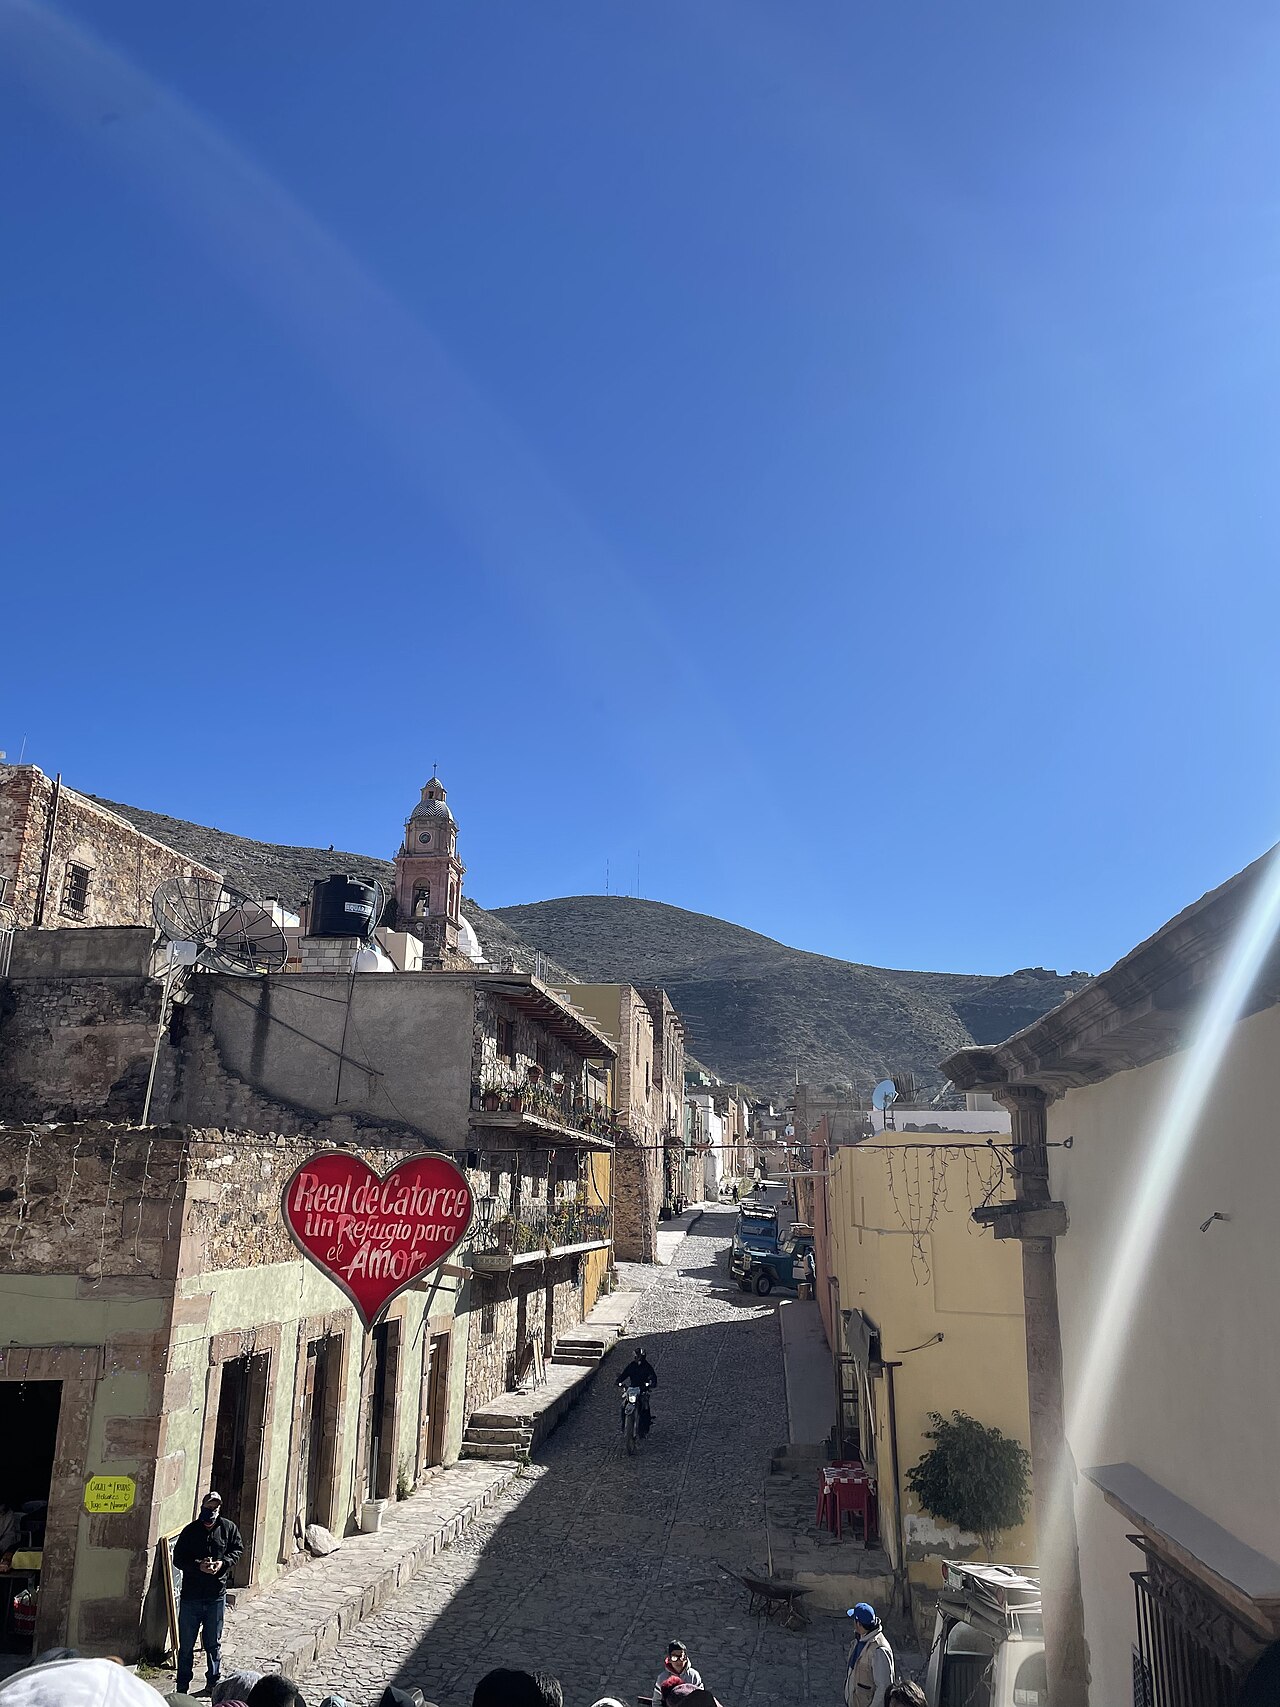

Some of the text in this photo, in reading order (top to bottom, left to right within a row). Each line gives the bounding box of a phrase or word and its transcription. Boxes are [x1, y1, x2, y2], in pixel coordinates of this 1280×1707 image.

[294, 1173, 468, 1218] Real de Catorce
[304, 1213, 456, 1250] Un Refugio para
[326, 1239, 428, 1281] el Amor
